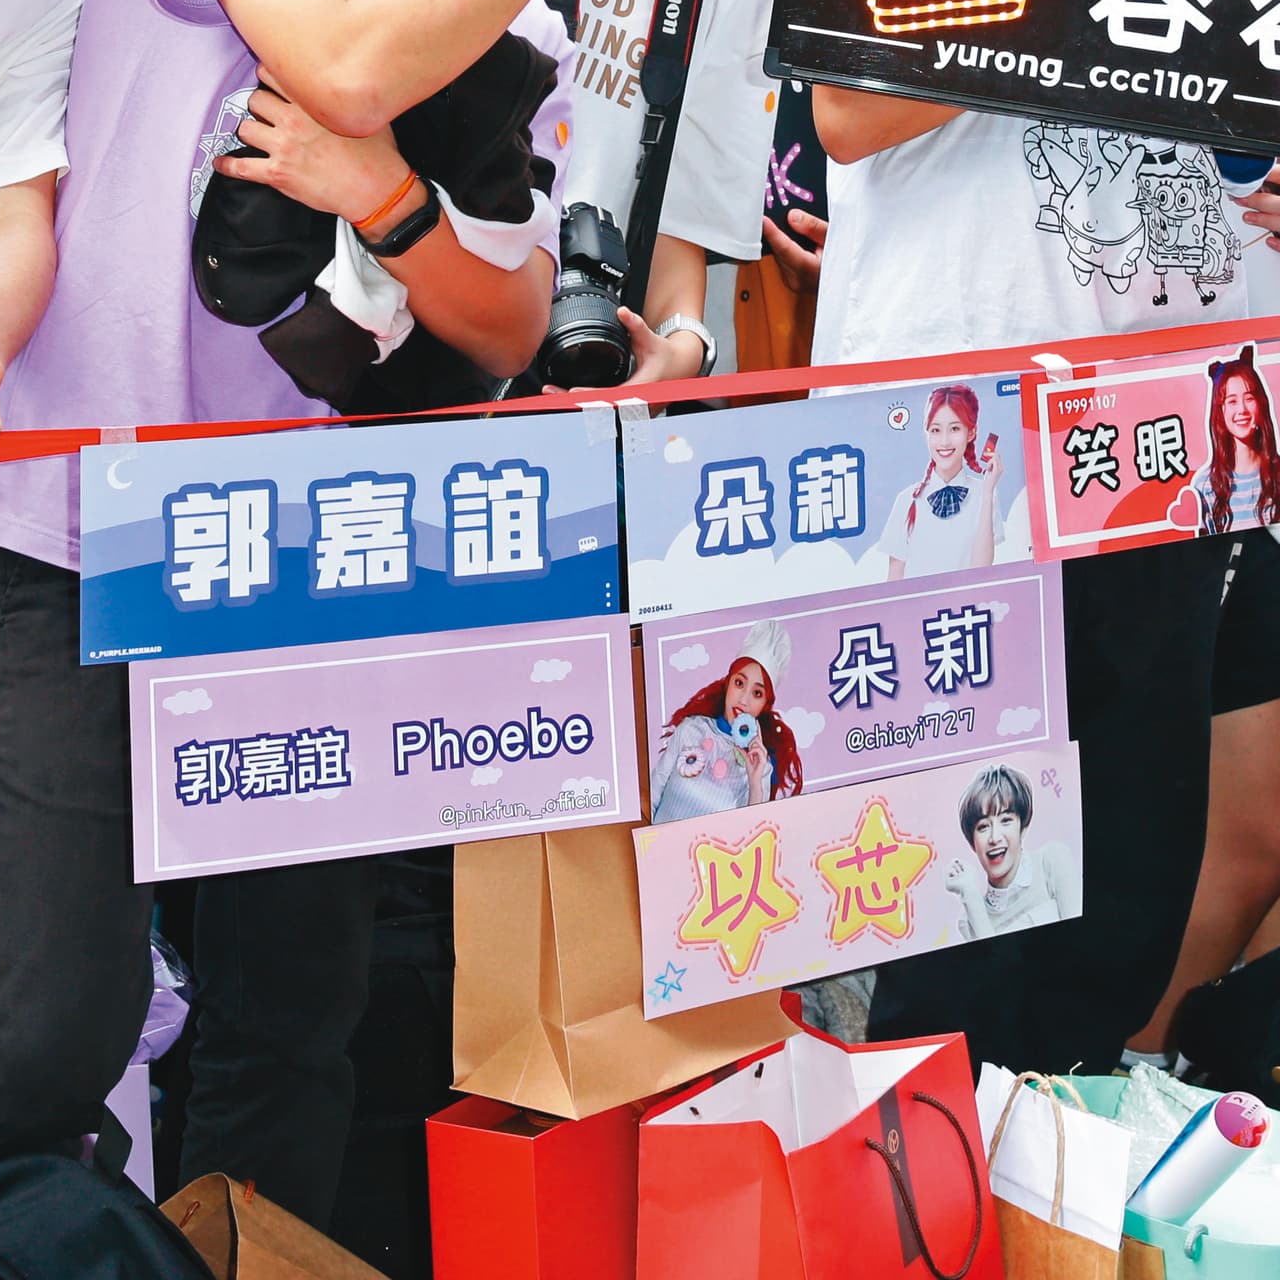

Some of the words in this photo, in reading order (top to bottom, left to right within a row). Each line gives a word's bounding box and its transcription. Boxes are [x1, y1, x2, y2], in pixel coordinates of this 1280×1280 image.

[933, 39, 1229, 105] yurong_ccc1107
[600, 262, 624, 278] Canon
[1057, 393, 1118, 415] 19991107
[1064, 416, 1189, 497] 笑眼
[167, 465, 547, 606] 郭嘉誼
[699, 449, 864, 553] 朵莉
[830, 605, 995, 710] 朵莉
[176, 727, 351, 805] 郭嘉誼
[394, 707, 594, 775] Phoebe
[845, 706, 977, 755] @chiayi727
[702, 843, 902, 930] 以芯
